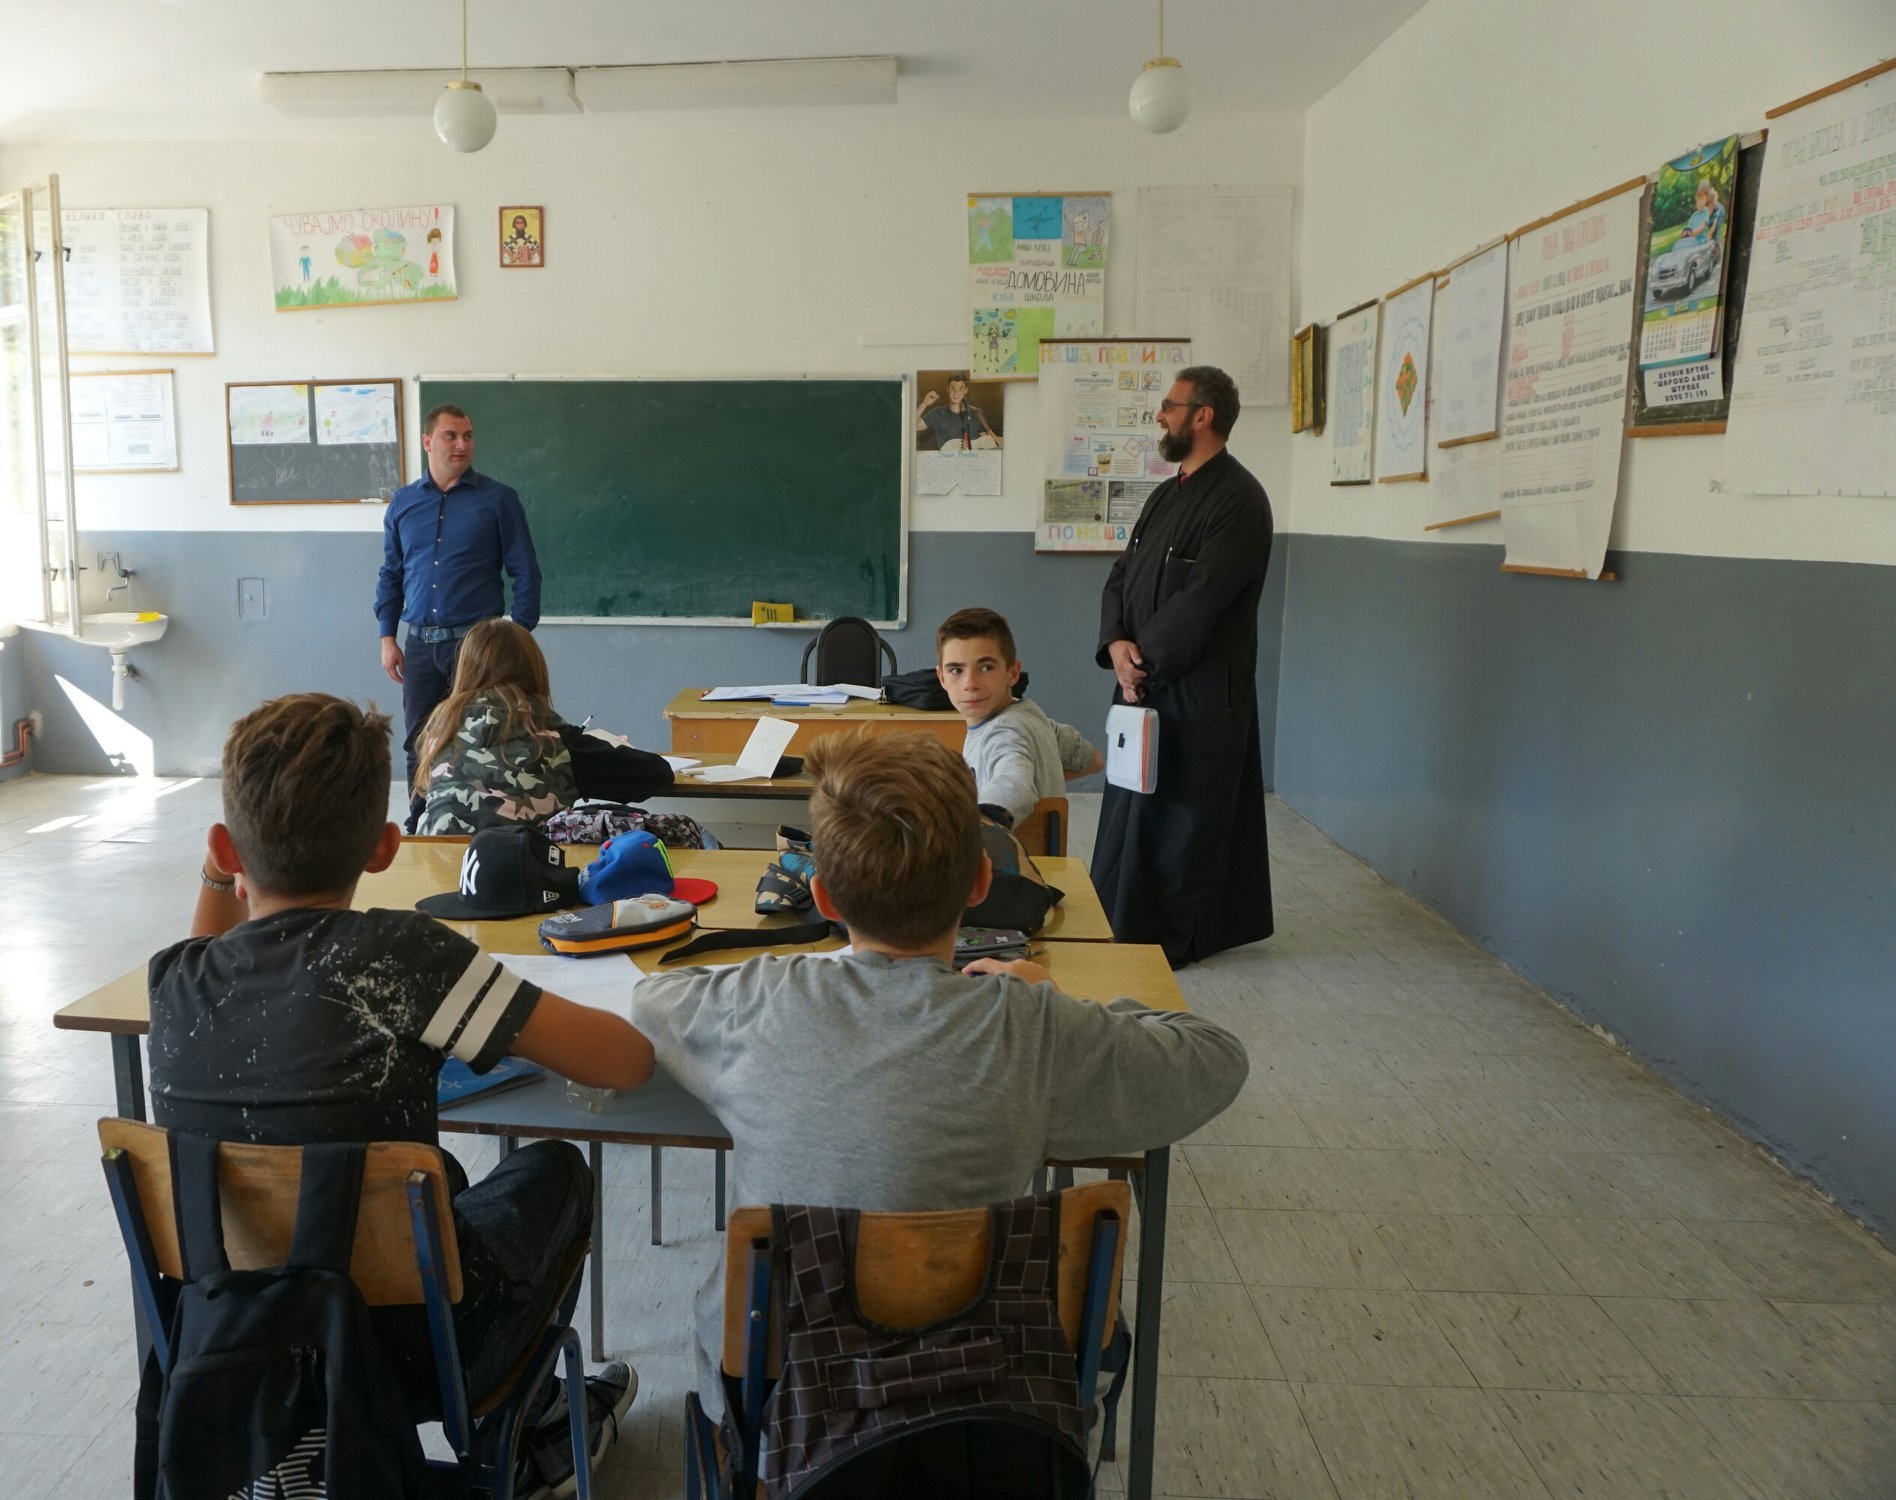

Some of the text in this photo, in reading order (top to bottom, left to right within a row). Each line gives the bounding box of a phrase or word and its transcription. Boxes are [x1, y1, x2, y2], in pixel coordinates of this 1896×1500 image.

[64, 210, 151, 222] ВЕЛИКО СЛОВО
[283, 213, 353, 235] ЧУВАЈМО
[1016, 242, 1032, 252] НАШ
[1004, 270, 1086, 296] ДОМОВИНА
[1024, 291, 1054, 303] ШКОЛА
[1040, 344, 1186, 369] Наша правила
